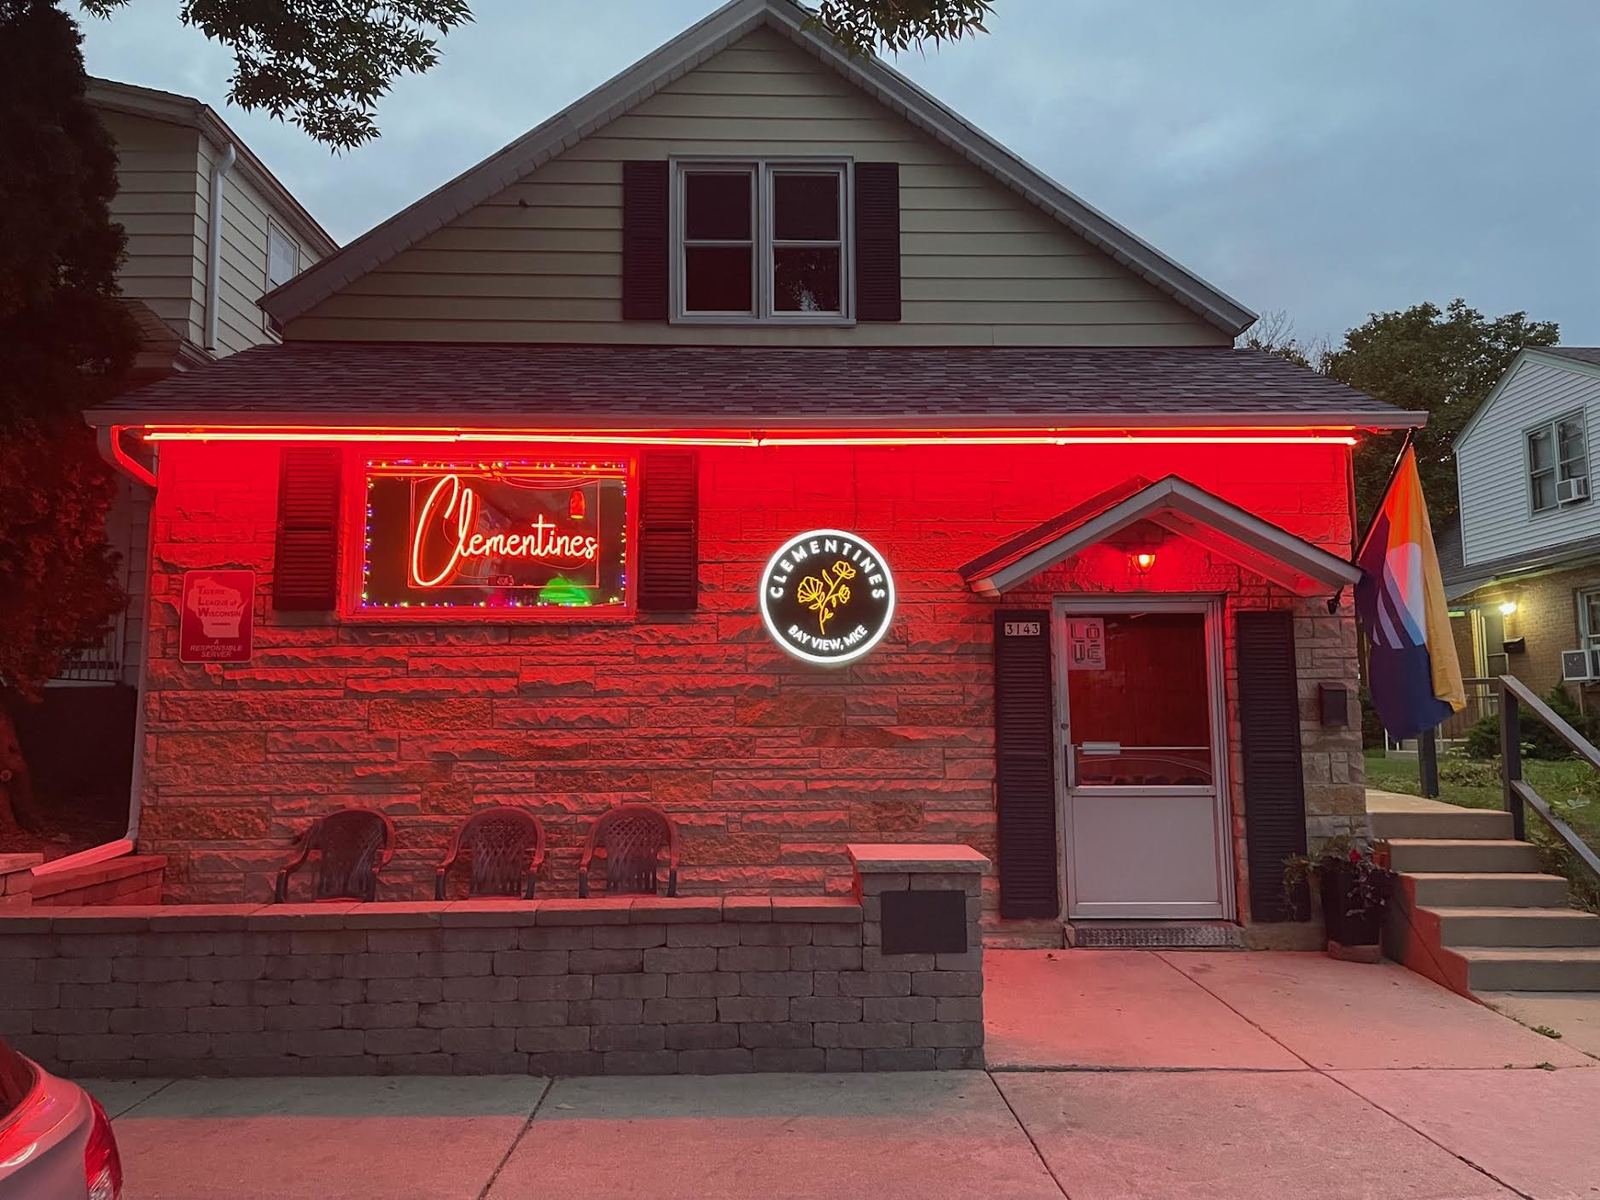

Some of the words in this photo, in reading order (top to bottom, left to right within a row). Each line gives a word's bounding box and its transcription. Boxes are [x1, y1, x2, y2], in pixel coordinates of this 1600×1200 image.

[412, 474, 598, 586] Clementines
[770, 539, 885, 599] CLEMENTINES
[788, 625, 811, 644] BAY
[811, 638, 844, 651] VIEW,
[842, 624, 868, 646] MKE
[1006, 623, 1039, 635] 3143
